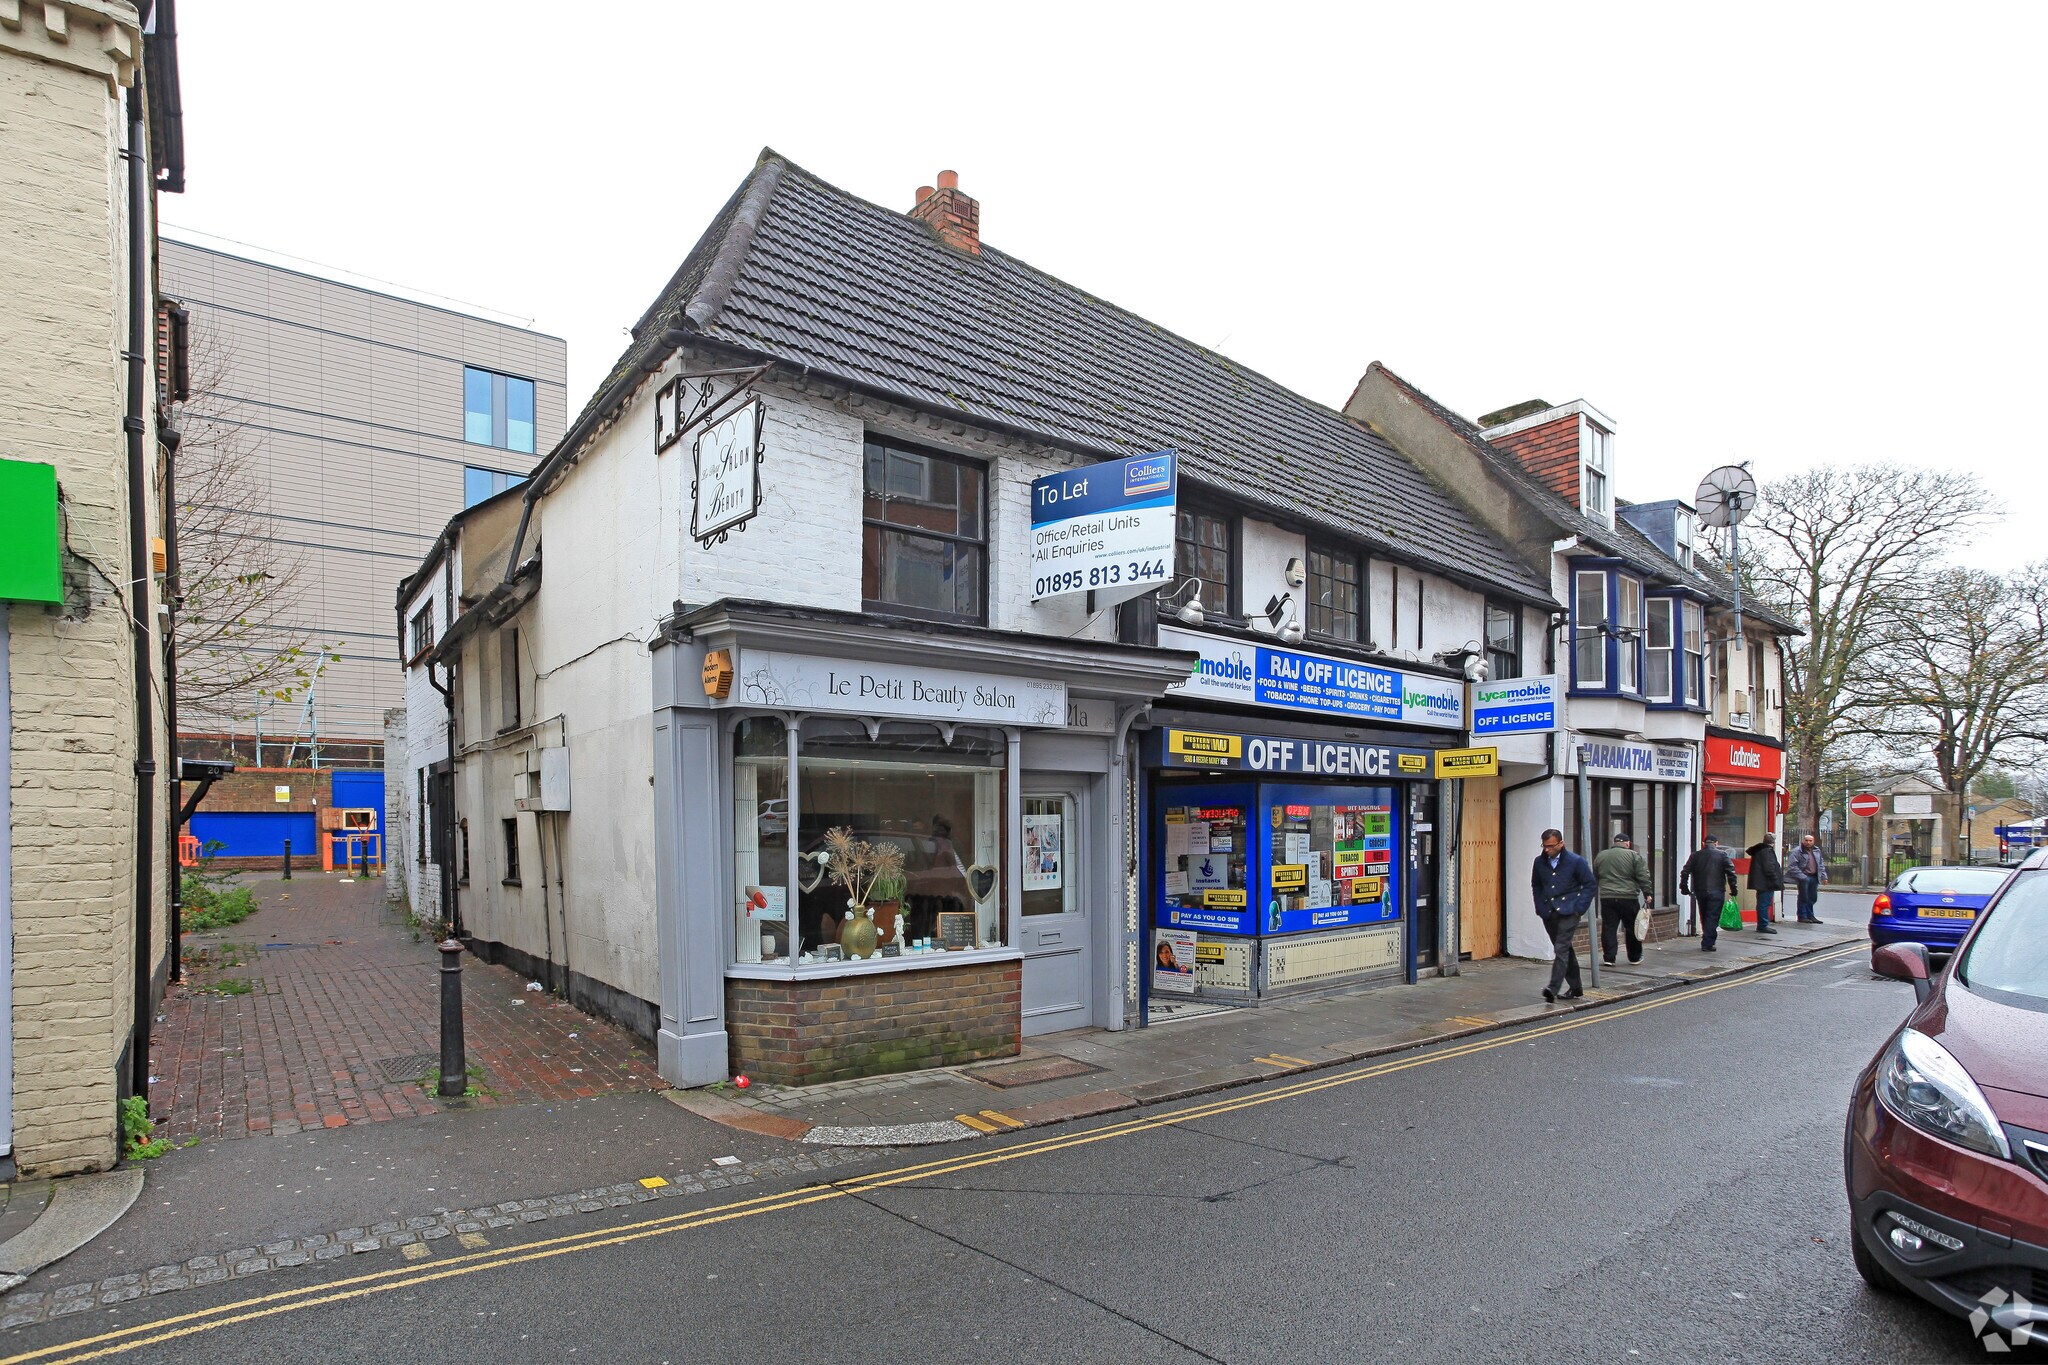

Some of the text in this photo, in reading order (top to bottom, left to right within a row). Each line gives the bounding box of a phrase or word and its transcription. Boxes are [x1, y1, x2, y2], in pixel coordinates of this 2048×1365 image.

[1129, 473, 1165, 484] INTERNATIONAL
[1130, 464, 1165, 478] Colliers
[1038, 478, 1089, 506] To Let
[1036, 515, 1141, 546] Office/Retail Units
[1035, 539, 1105, 562] All Enquiries
[1094, 543, 1171, 559] www.colliers.com/uk/industrial
[1035, 559, 1165, 596] 01895 813 344
[1192, 656, 1252, 681] amobile
[1270, 655, 1392, 694] RAJ OFF LICENCE
[828, 672, 1016, 711] Le Petit Beauty Salon
[1026, 681, 1063, 691] 01895 233 733
[1200, 677, 1211, 686] Call
[1211, 679, 1220, 687] the
[1220, 680, 1234, 689] world
[1241, 683, 1252, 691] less
[1259, 678, 1401, 706] FOOD & WINE BEERS SPIRITS DRINKS CIGARETTES
[1403, 687, 1459, 712] Lycamobile
[1478, 684, 1551, 703] Lycamobile
[1266, 690, 1399, 716] TOBACCO PHONE TOP-UPS GROCERY PAY POINT
[1477, 711, 1552, 727] OFF LICENCE
[1184, 735, 1210, 745] WESTERN
[1192, 742, 1211, 750] UNION
[1248, 739, 1390, 776] OFF LICENCE
[1583, 742, 1653, 772] MARANATHA
[1730, 744, 1760, 769] Ladbrokes
[207, 766, 220, 775] 20
[1286, 804, 1310, 816] OPEN
[1340, 853, 1360, 862] TOBACCO
[1340, 866, 1359, 877] SPIRITS
[1367, 864, 1389, 875] TOILETRIES
[1923, 909, 1968, 918] W518 UBH
[1161, 932, 1191, 940] Lycamobile
